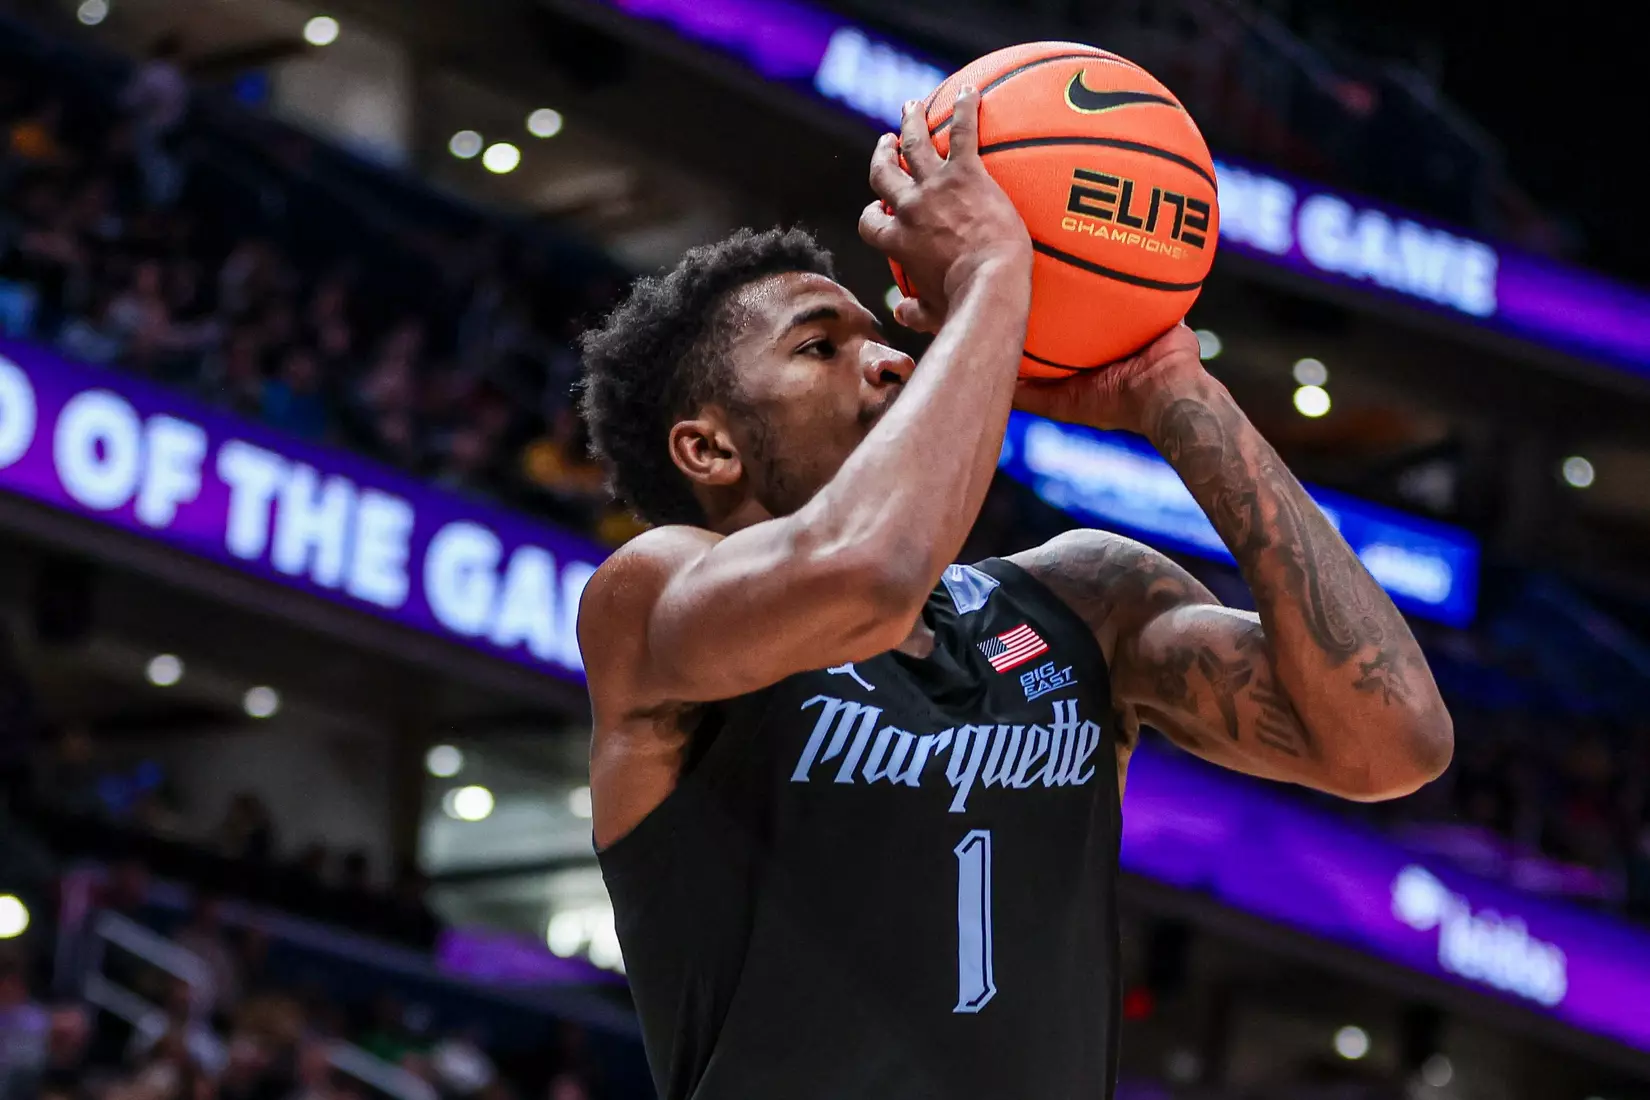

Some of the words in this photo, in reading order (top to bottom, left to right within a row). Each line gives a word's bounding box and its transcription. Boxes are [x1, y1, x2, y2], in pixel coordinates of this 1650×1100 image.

[1066, 167, 1210, 250] ELITE
[1299, 193, 1499, 318] GAME
[54, 388, 207, 528] OF
[218, 438, 414, 609] THE
[1020, 661, 1055, 687] BIG
[1024, 666, 1072, 697] EAST
[790, 694, 1101, 813] Marquette
[953, 829, 997, 1014] 1
